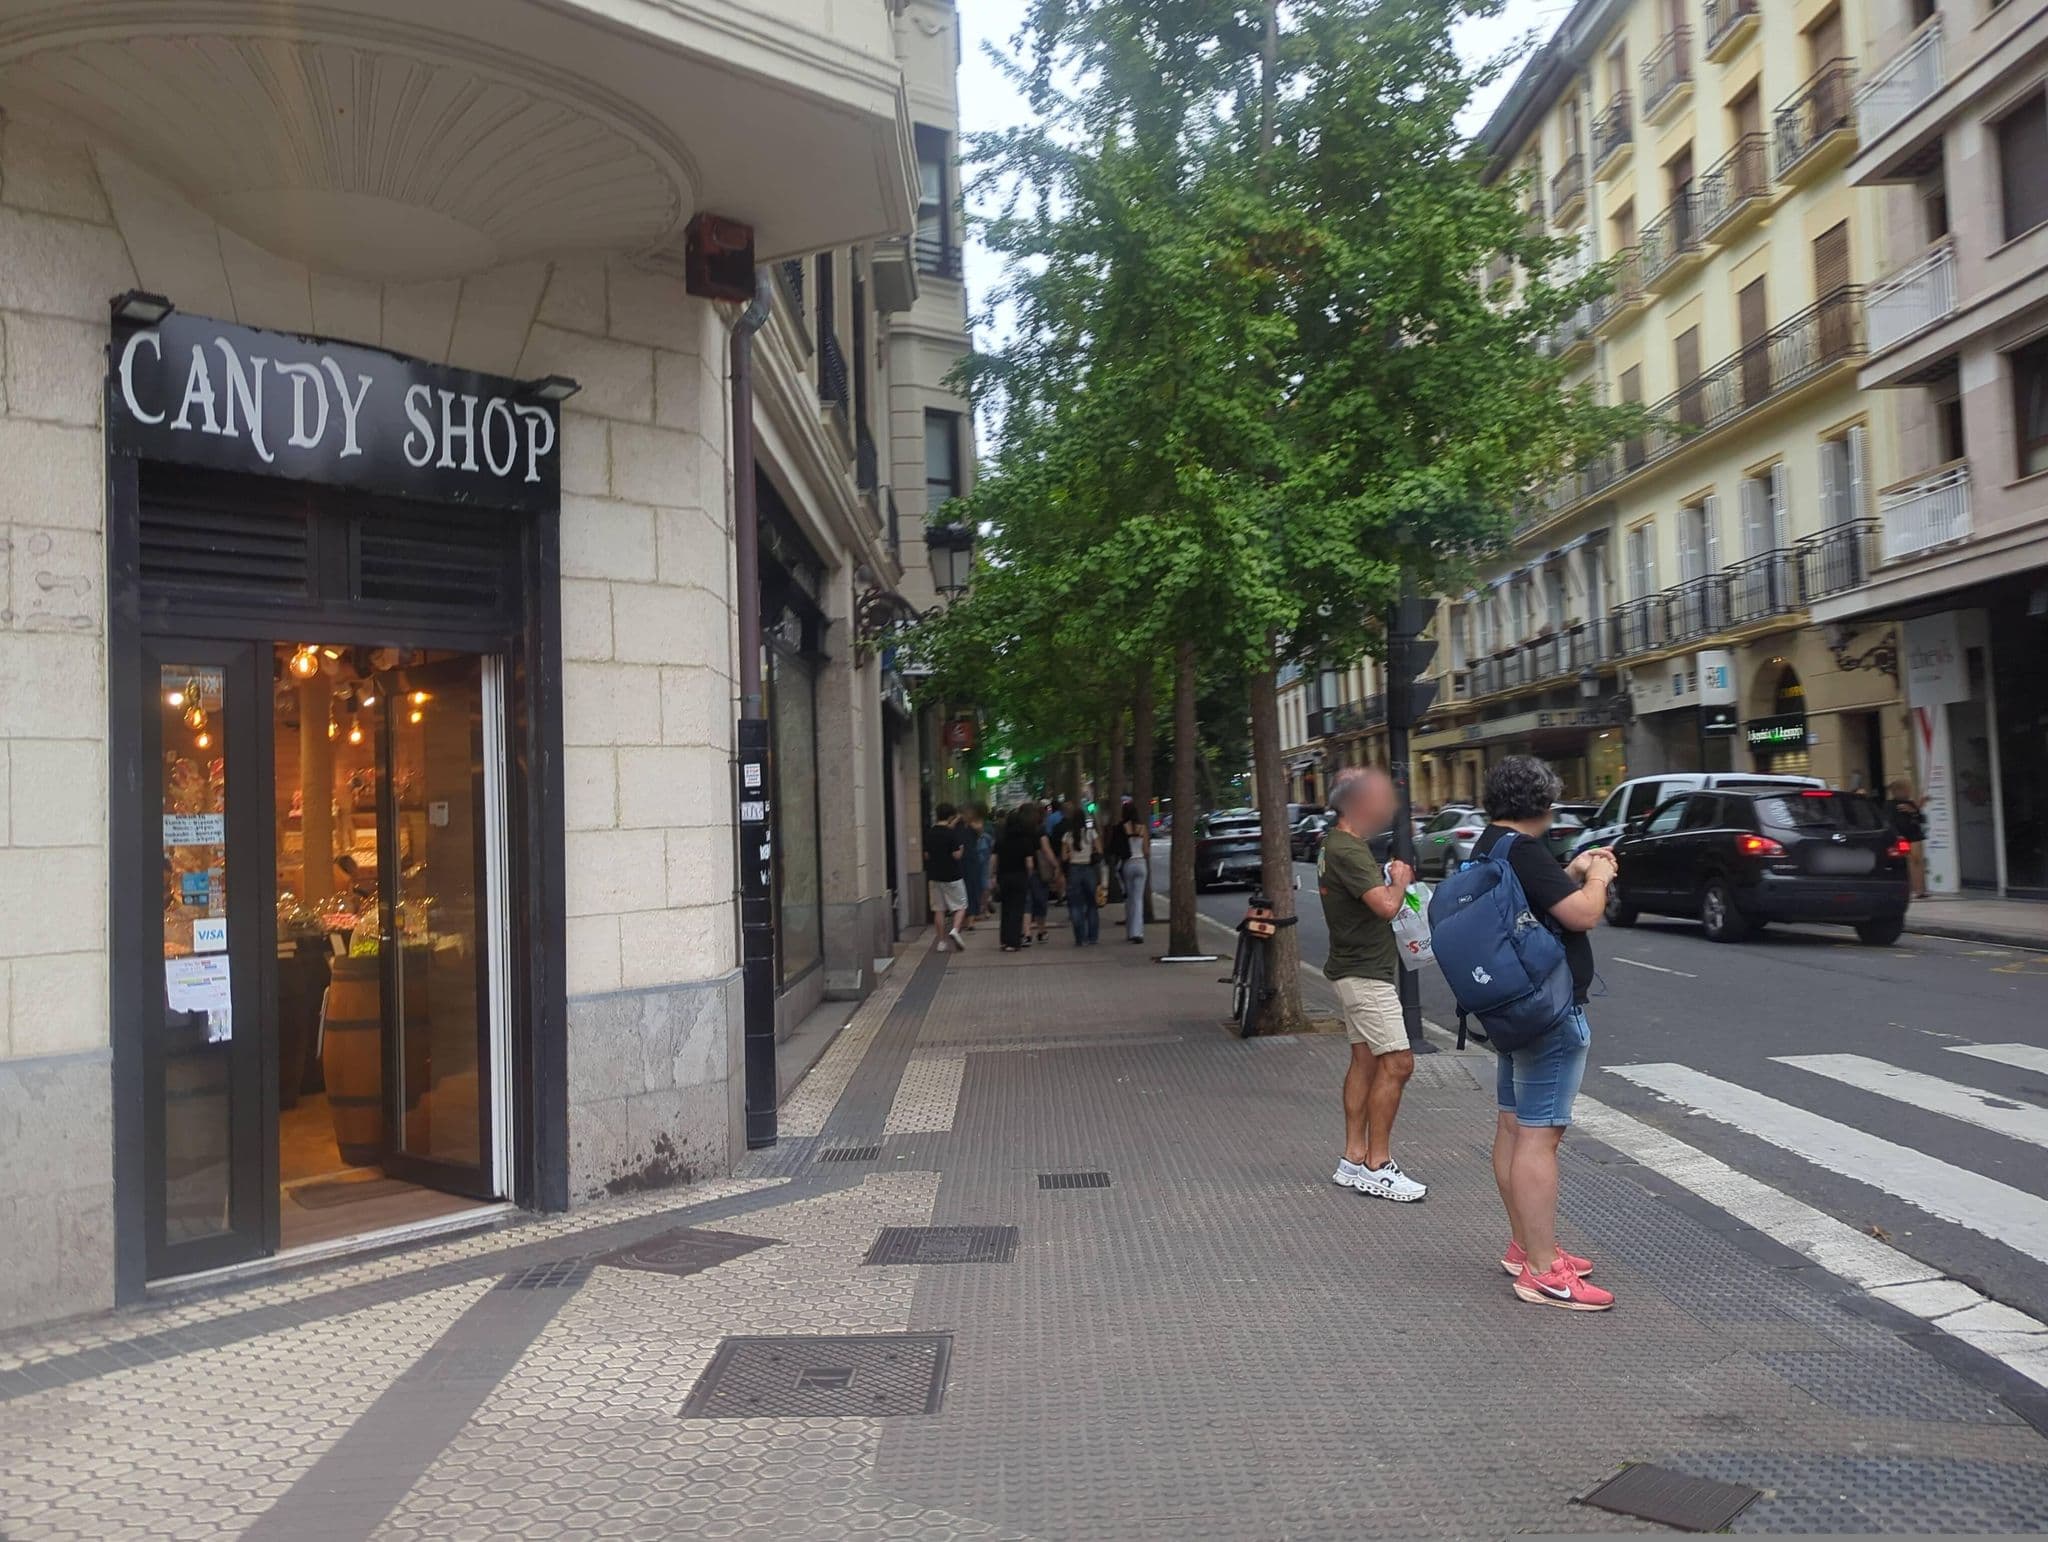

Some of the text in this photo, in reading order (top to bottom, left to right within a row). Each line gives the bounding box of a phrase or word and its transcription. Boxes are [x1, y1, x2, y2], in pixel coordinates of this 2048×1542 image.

[119, 331, 555, 483] CANDY SHOP
[198, 929, 225, 940] VISA
